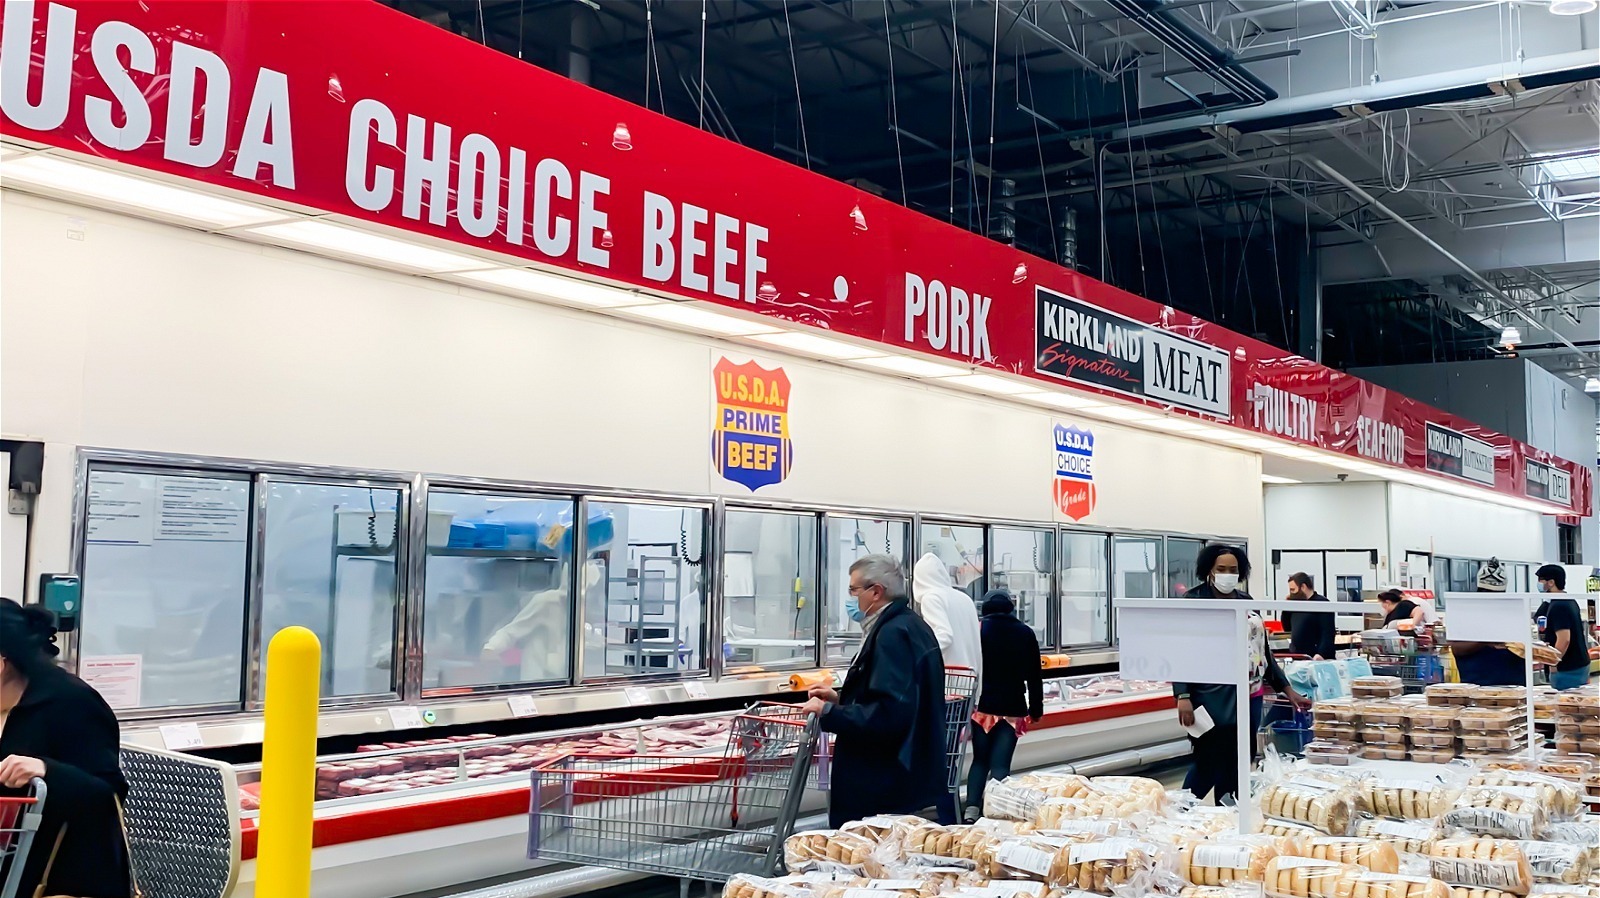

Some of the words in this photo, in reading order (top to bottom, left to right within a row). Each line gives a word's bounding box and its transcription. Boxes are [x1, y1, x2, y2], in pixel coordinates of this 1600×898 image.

[0, 0, 296, 190] USDA
[345, 98, 611, 270] CHOICE
[642, 191, 770, 304] BEEF
[904, 271, 993, 362] PORK
[1043, 301, 1141, 364] KIRKLAND
[1042, 342, 1141, 378] Signature
[1153, 342, 1222, 404] MEAT
[720, 371, 785, 407] U.S.D.A.
[723, 408, 782, 435] PRIME
[1253, 381, 1317, 442] POULTRY
[727, 440, 778, 471] BEEF
[1056, 430, 1093, 451] U.S.D.A.
[1356, 414, 1405, 464] SEAFOOD
[1427, 428, 1462, 458] KIRKLAND
[1057, 453, 1092, 473] CHOICE
[1062, 487, 1087, 513] Grade
[1552, 473, 1568, 500] DELI
